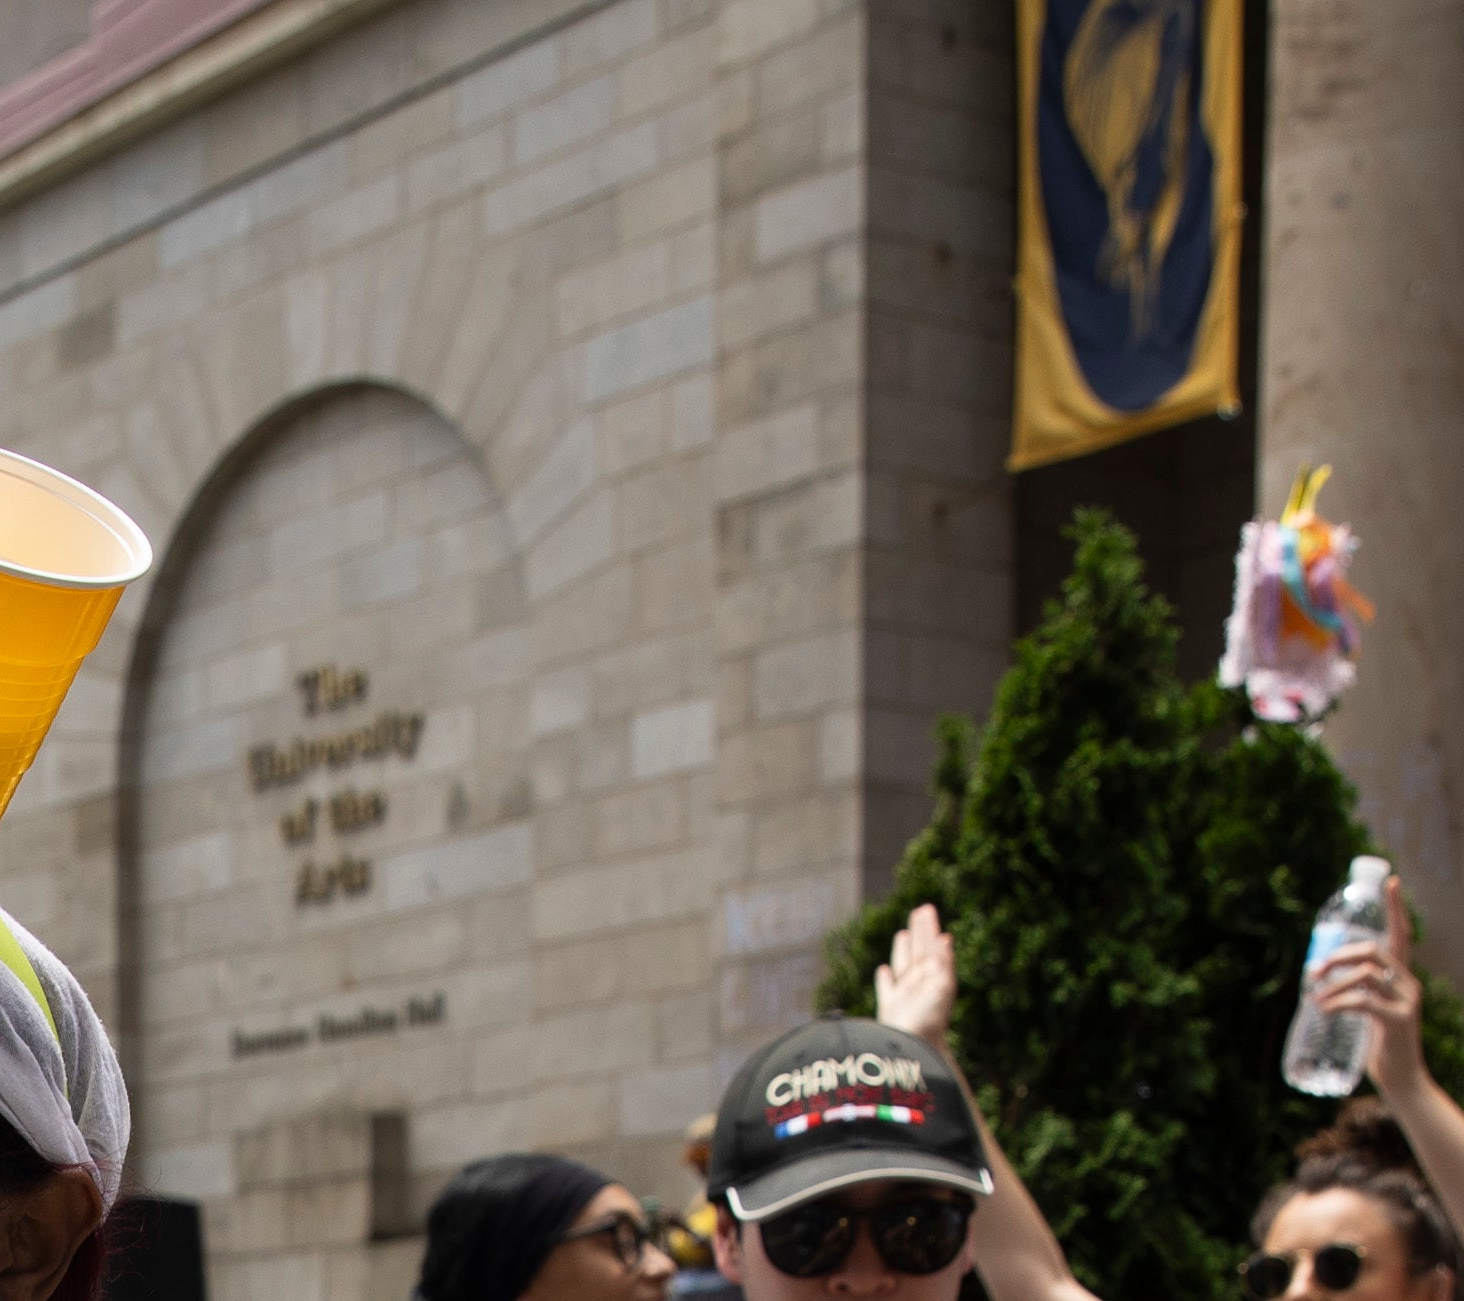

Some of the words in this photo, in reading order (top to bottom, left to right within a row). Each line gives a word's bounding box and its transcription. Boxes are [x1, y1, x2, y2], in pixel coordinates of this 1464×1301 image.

[295, 661, 369, 719] The
[248, 709, 426, 796] University
[278, 795, 318, 846] of
[329, 787, 387, 836] the
[294, 855, 372, 909] Arts
[765, 1052, 927, 1107] CHAMONIX
